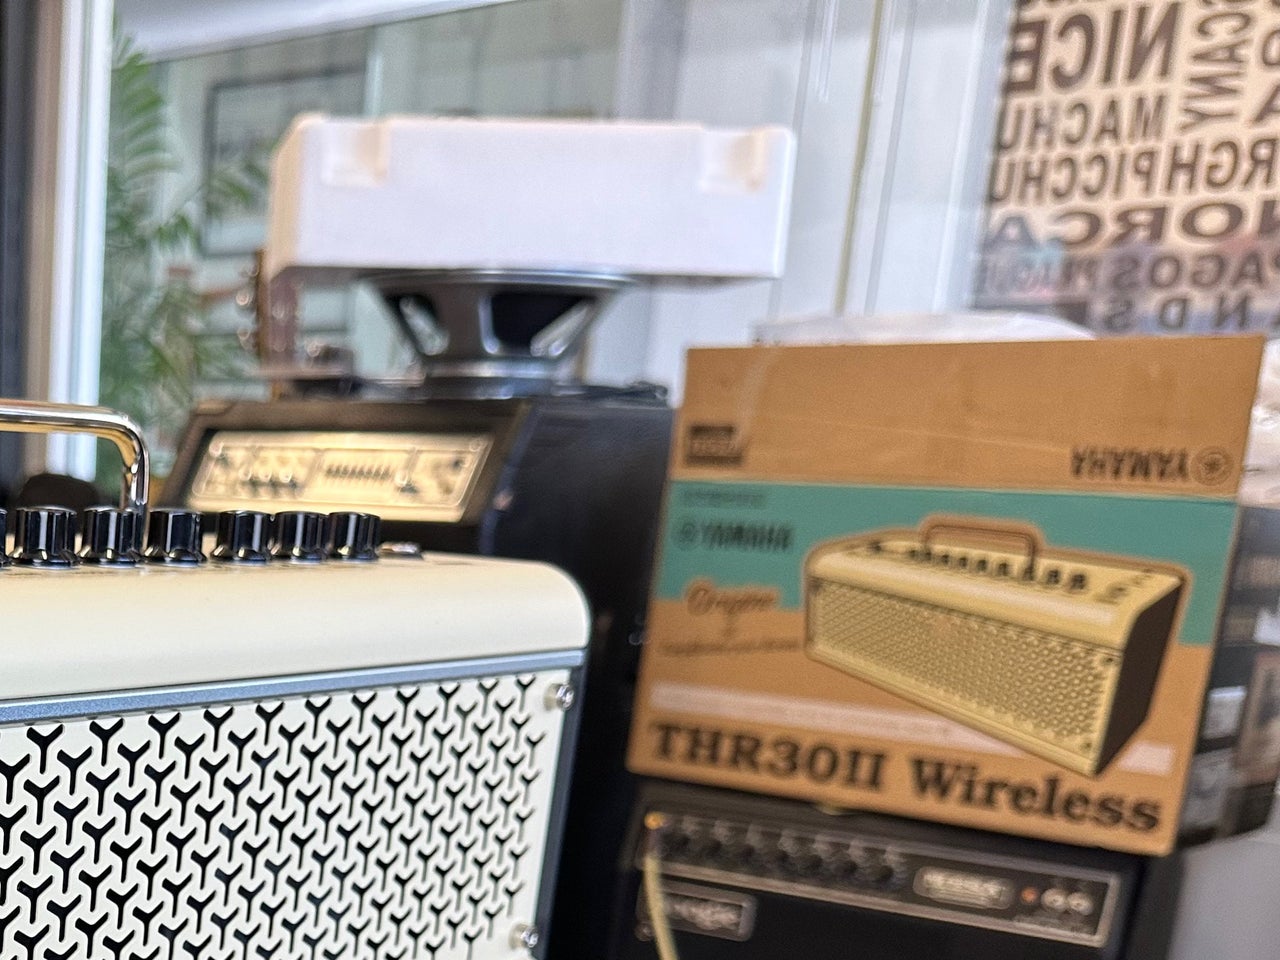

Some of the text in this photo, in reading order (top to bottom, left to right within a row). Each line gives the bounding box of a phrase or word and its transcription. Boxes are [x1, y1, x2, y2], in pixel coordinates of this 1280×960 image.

[1070, 444, 1190, 480] YAMAHA
[654, 722, 1161, 833] THR30II Wireless
